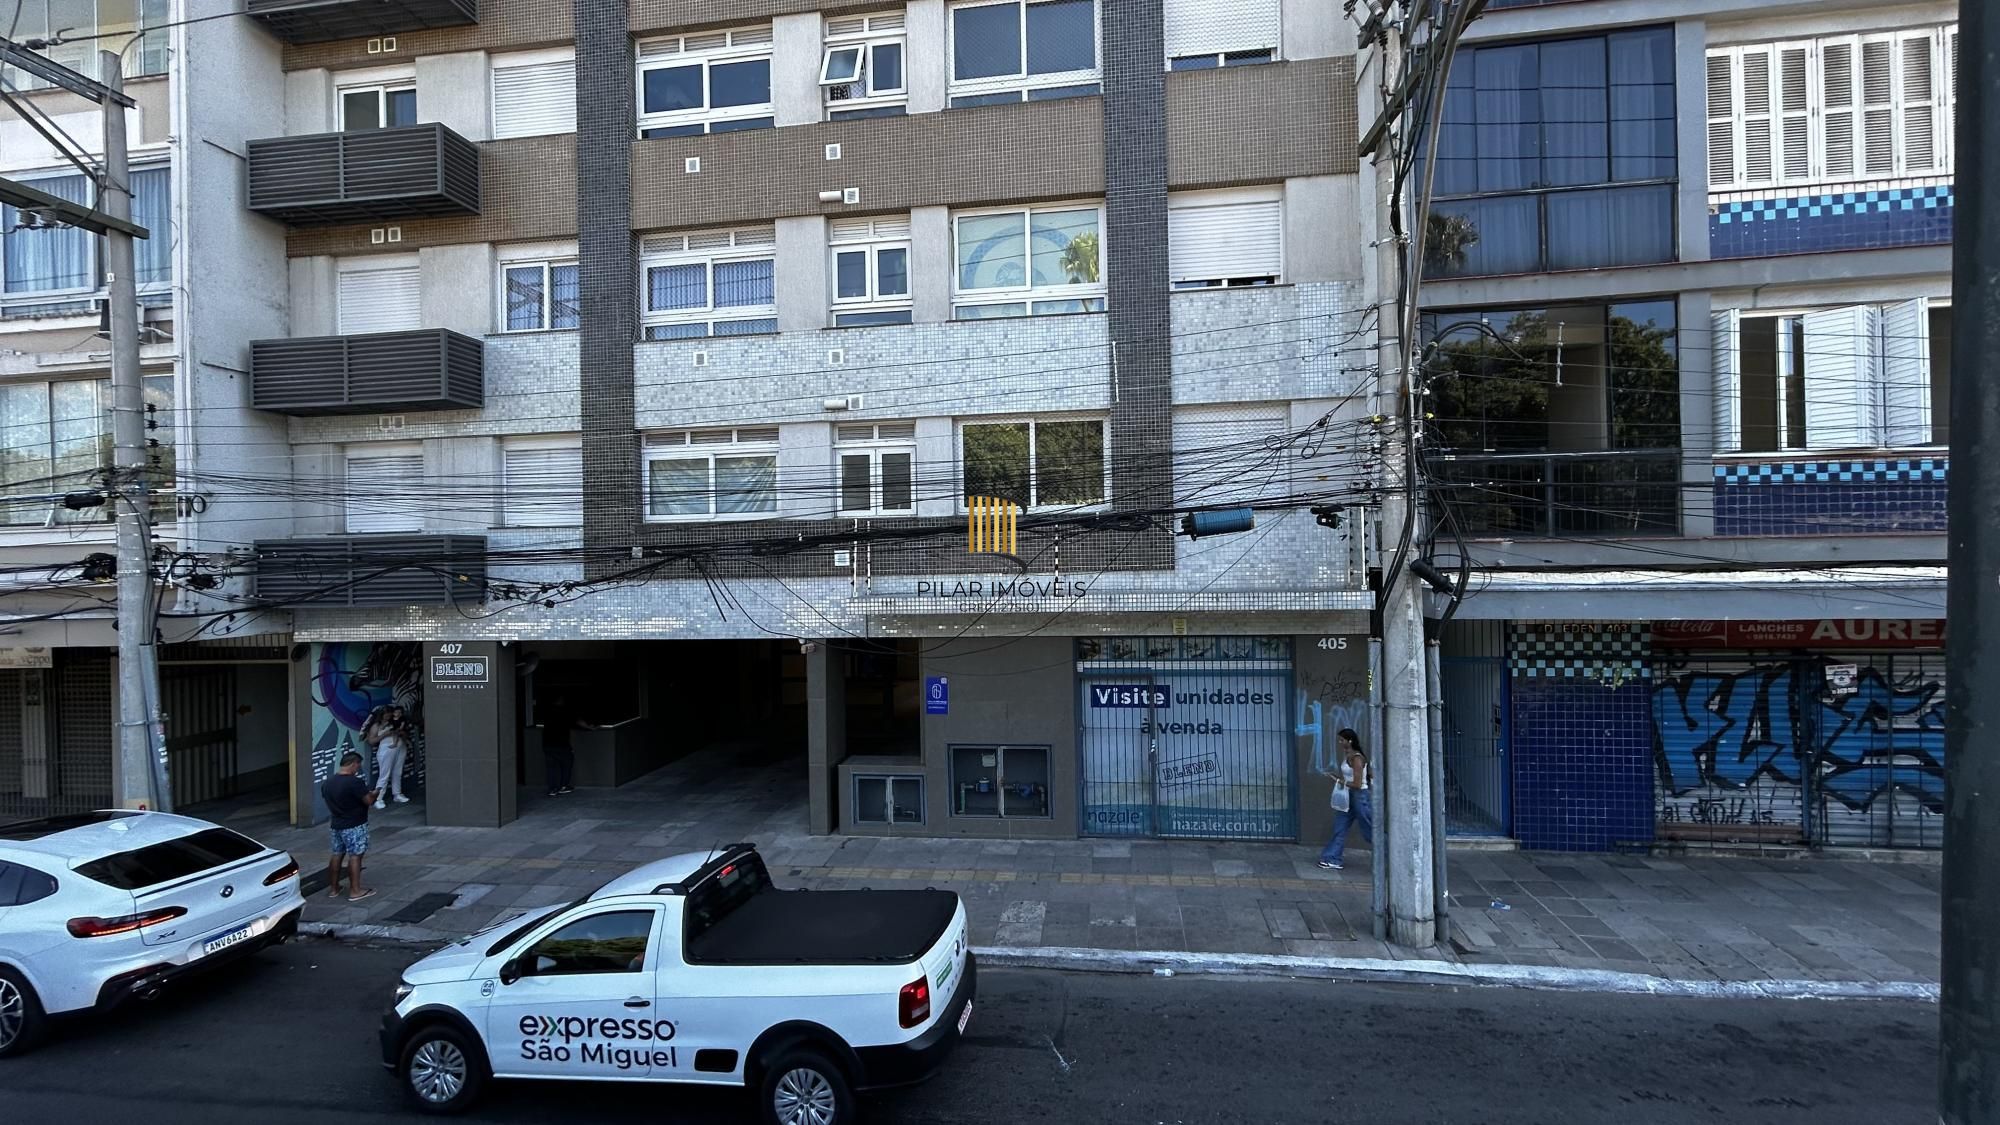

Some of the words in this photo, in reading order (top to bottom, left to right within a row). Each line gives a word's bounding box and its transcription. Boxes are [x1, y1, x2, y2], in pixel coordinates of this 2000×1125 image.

[1562, 624, 1597, 633] EDEN
[1606, 624, 1628, 633] 403
[1738, 623, 1805, 633] LANCHES
[440, 643, 463, 654] 407
[1317, 637, 1347, 650] 405
[435, 662, 484, 676] BLEND
[1095, 687, 1166, 705] Visite
[1175, 688, 1275, 705] unidades
[1158, 718, 1223, 735] venda
[1162, 759, 1216, 781] BLEND
[1087, 808, 1140, 825] nazale
[1172, 817, 1279, 833] nazale.com.br
[209, 929, 249, 952] ANV6A22
[520, 1038, 571, 1062] São
[580, 1042, 678, 1070] Miguel
